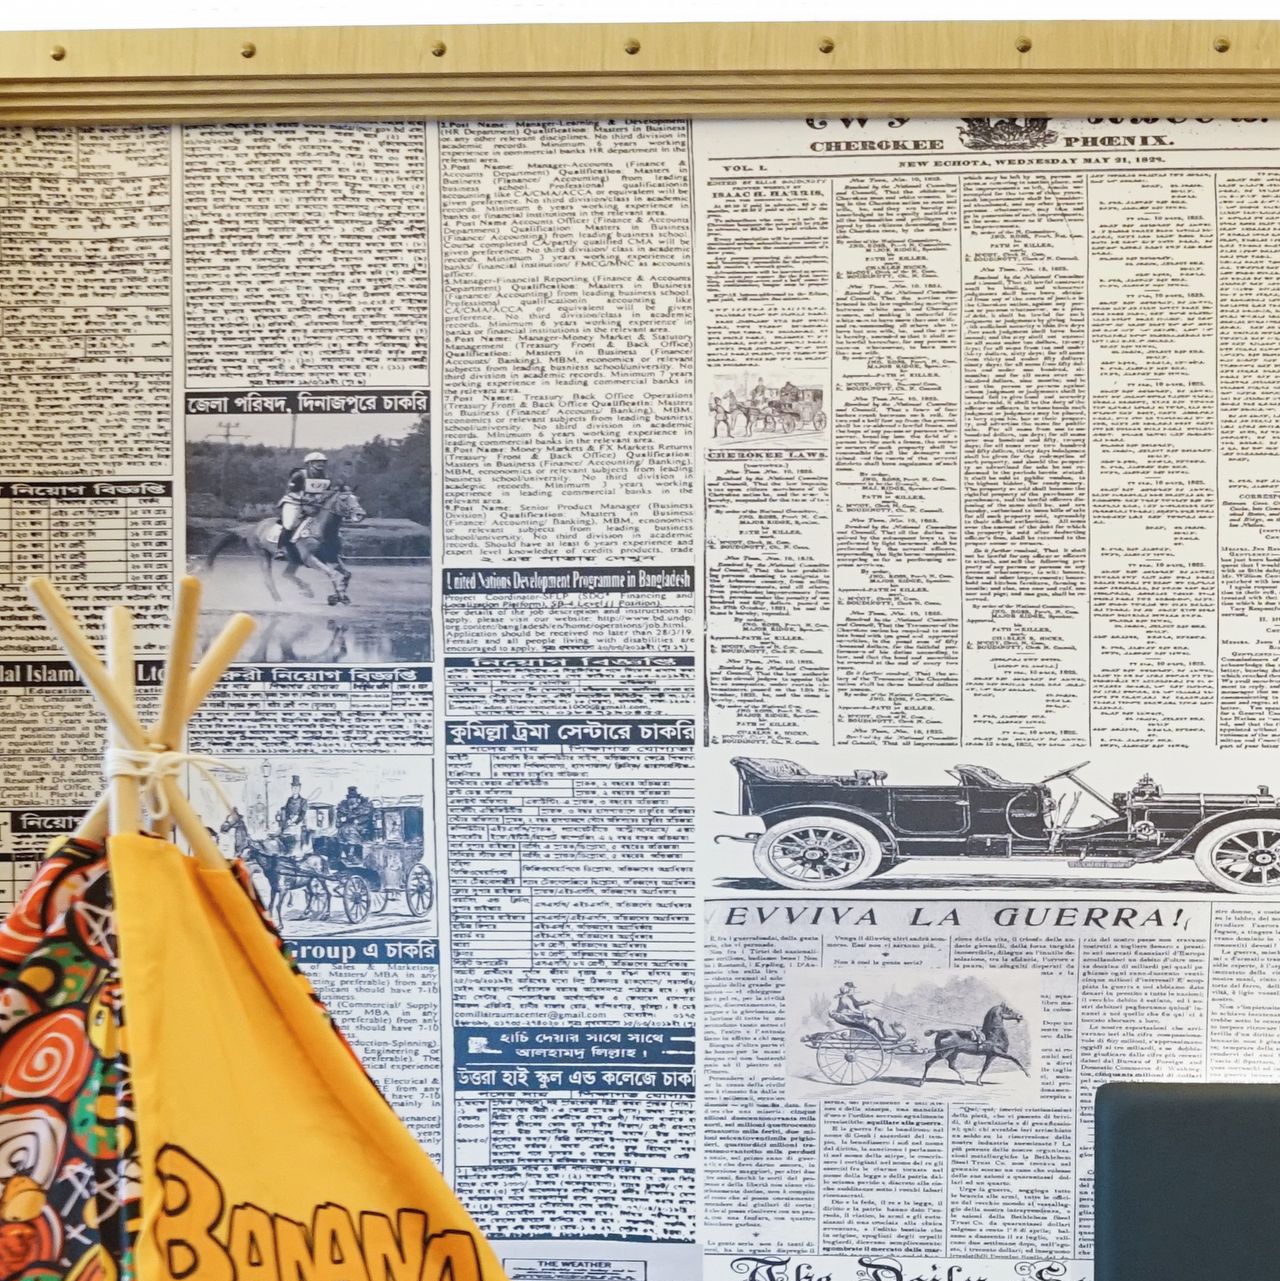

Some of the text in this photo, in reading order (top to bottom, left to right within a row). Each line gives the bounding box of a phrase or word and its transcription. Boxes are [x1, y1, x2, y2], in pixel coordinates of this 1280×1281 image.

[810, 140, 943, 152] CHEROKEE
[187, 397, 228, 413] জেলা
[382, 394, 427, 411] চাকরি
[513, 571, 570, 592] Development
[573, 571, 625, 589] Programme
[628, 570, 636, 587] in
[639, 570, 690, 588] Bangladesh
[640, 720, 695, 740] চাকরি
[725, 905, 1183, 928] EVVIVA LA GUERRA!
[363, 943, 378, 958] এ
[385, 938, 437, 959] চাকরি
